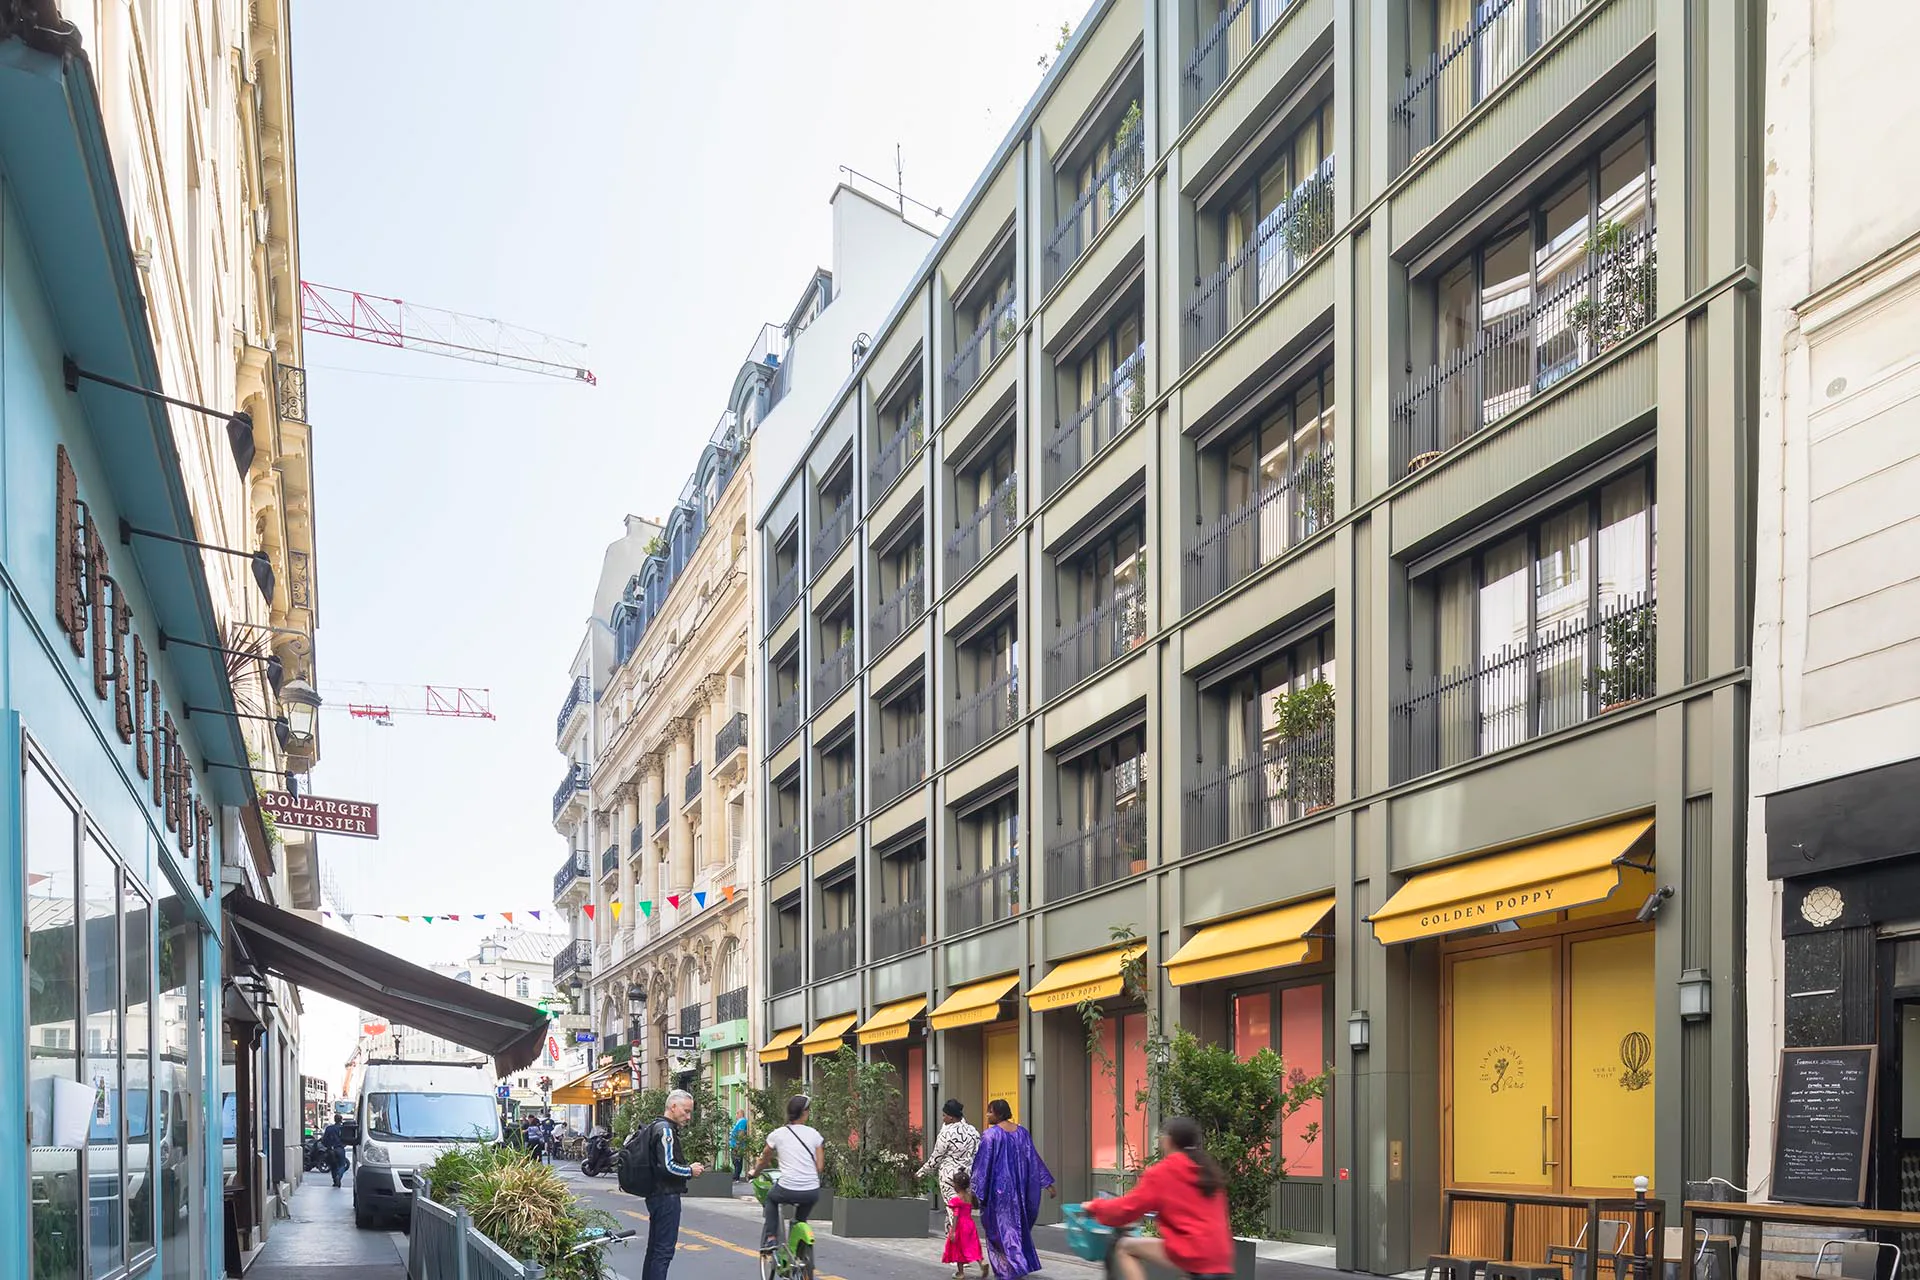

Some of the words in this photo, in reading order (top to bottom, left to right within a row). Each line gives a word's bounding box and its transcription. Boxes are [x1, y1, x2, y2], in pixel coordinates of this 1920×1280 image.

[266, 793, 371, 818] BOULANGER
[271, 809, 366, 832] PATISSIER
[1421, 904, 1485, 926] GOLDEN
[1496, 889, 1554, 910] POPPY
[1047, 991, 1075, 1003] GOLDEN
[1078, 984, 1102, 997] POPPY
